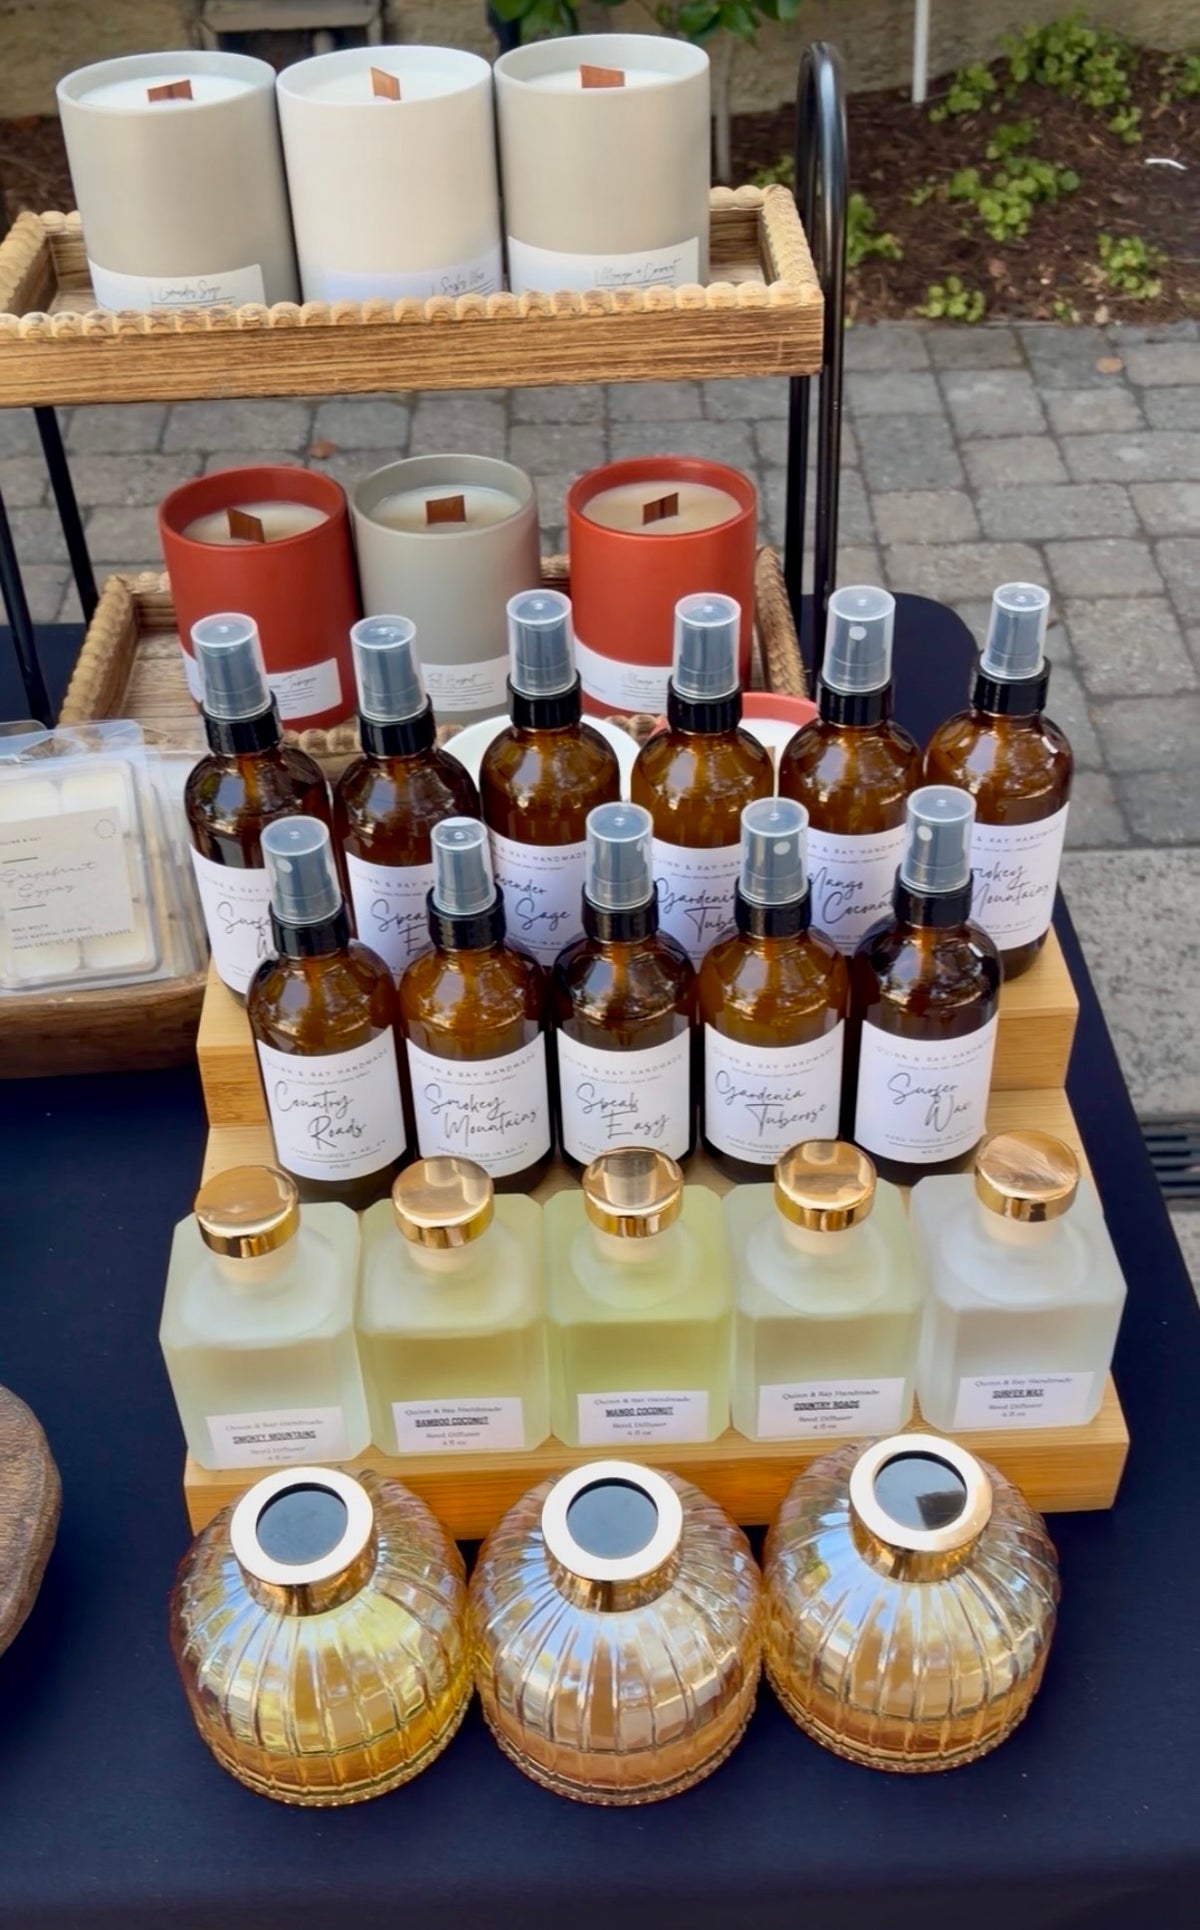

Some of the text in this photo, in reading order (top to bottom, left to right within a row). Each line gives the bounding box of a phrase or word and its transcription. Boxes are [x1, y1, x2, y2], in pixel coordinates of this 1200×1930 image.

[217, 901, 271, 936] Surfe
[370, 898, 428, 933] Spea
[515, 897, 570, 932] Sage
[275, 1080, 354, 1120] Country
[424, 1082, 505, 1121] Smokey
[576, 1082, 639, 1114] Speak
[715, 1069, 806, 1106] Gardenia
[887, 1072, 959, 1106] Surfer
[307, 1115, 368, 1150] Roads
[444, 1110, 536, 1147] Mountains
[601, 1109, 670, 1140] Easy
[744, 1103, 827, 1137] Tuberose
[793, 1400, 860, 1411] COUNTRY ROADS
[992, 1388, 1044, 1399] SURFER WAX
[415, 1416, 489, 1428] BAMBOO COCONUT
